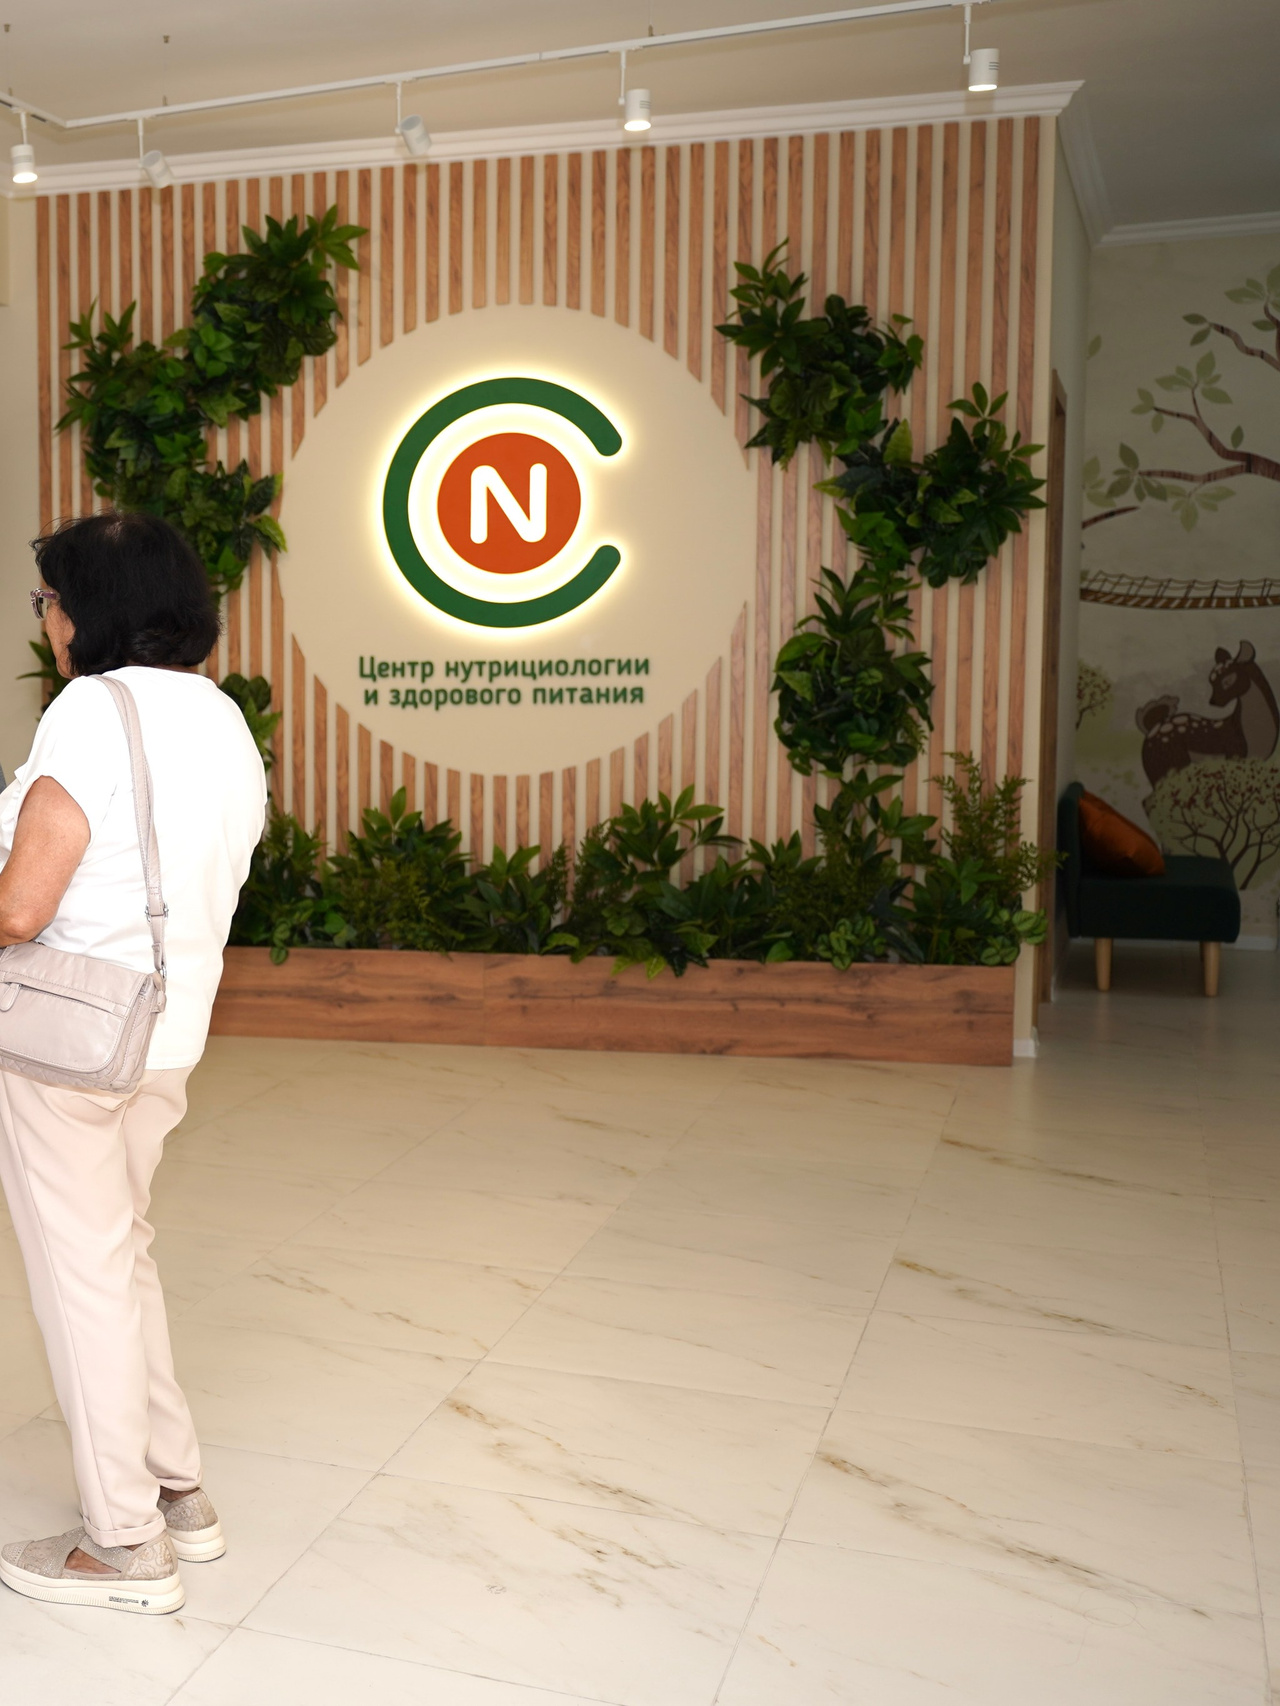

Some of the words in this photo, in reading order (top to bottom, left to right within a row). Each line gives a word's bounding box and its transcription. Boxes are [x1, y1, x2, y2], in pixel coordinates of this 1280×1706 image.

[470, 463, 548, 544] N
[359, 656, 434, 683] Центр
[445, 658, 650, 683] нутрициологии
[364, 689, 378, 705] и
[389, 687, 521, 711] здорового
[533, 686, 644, 704] питания
